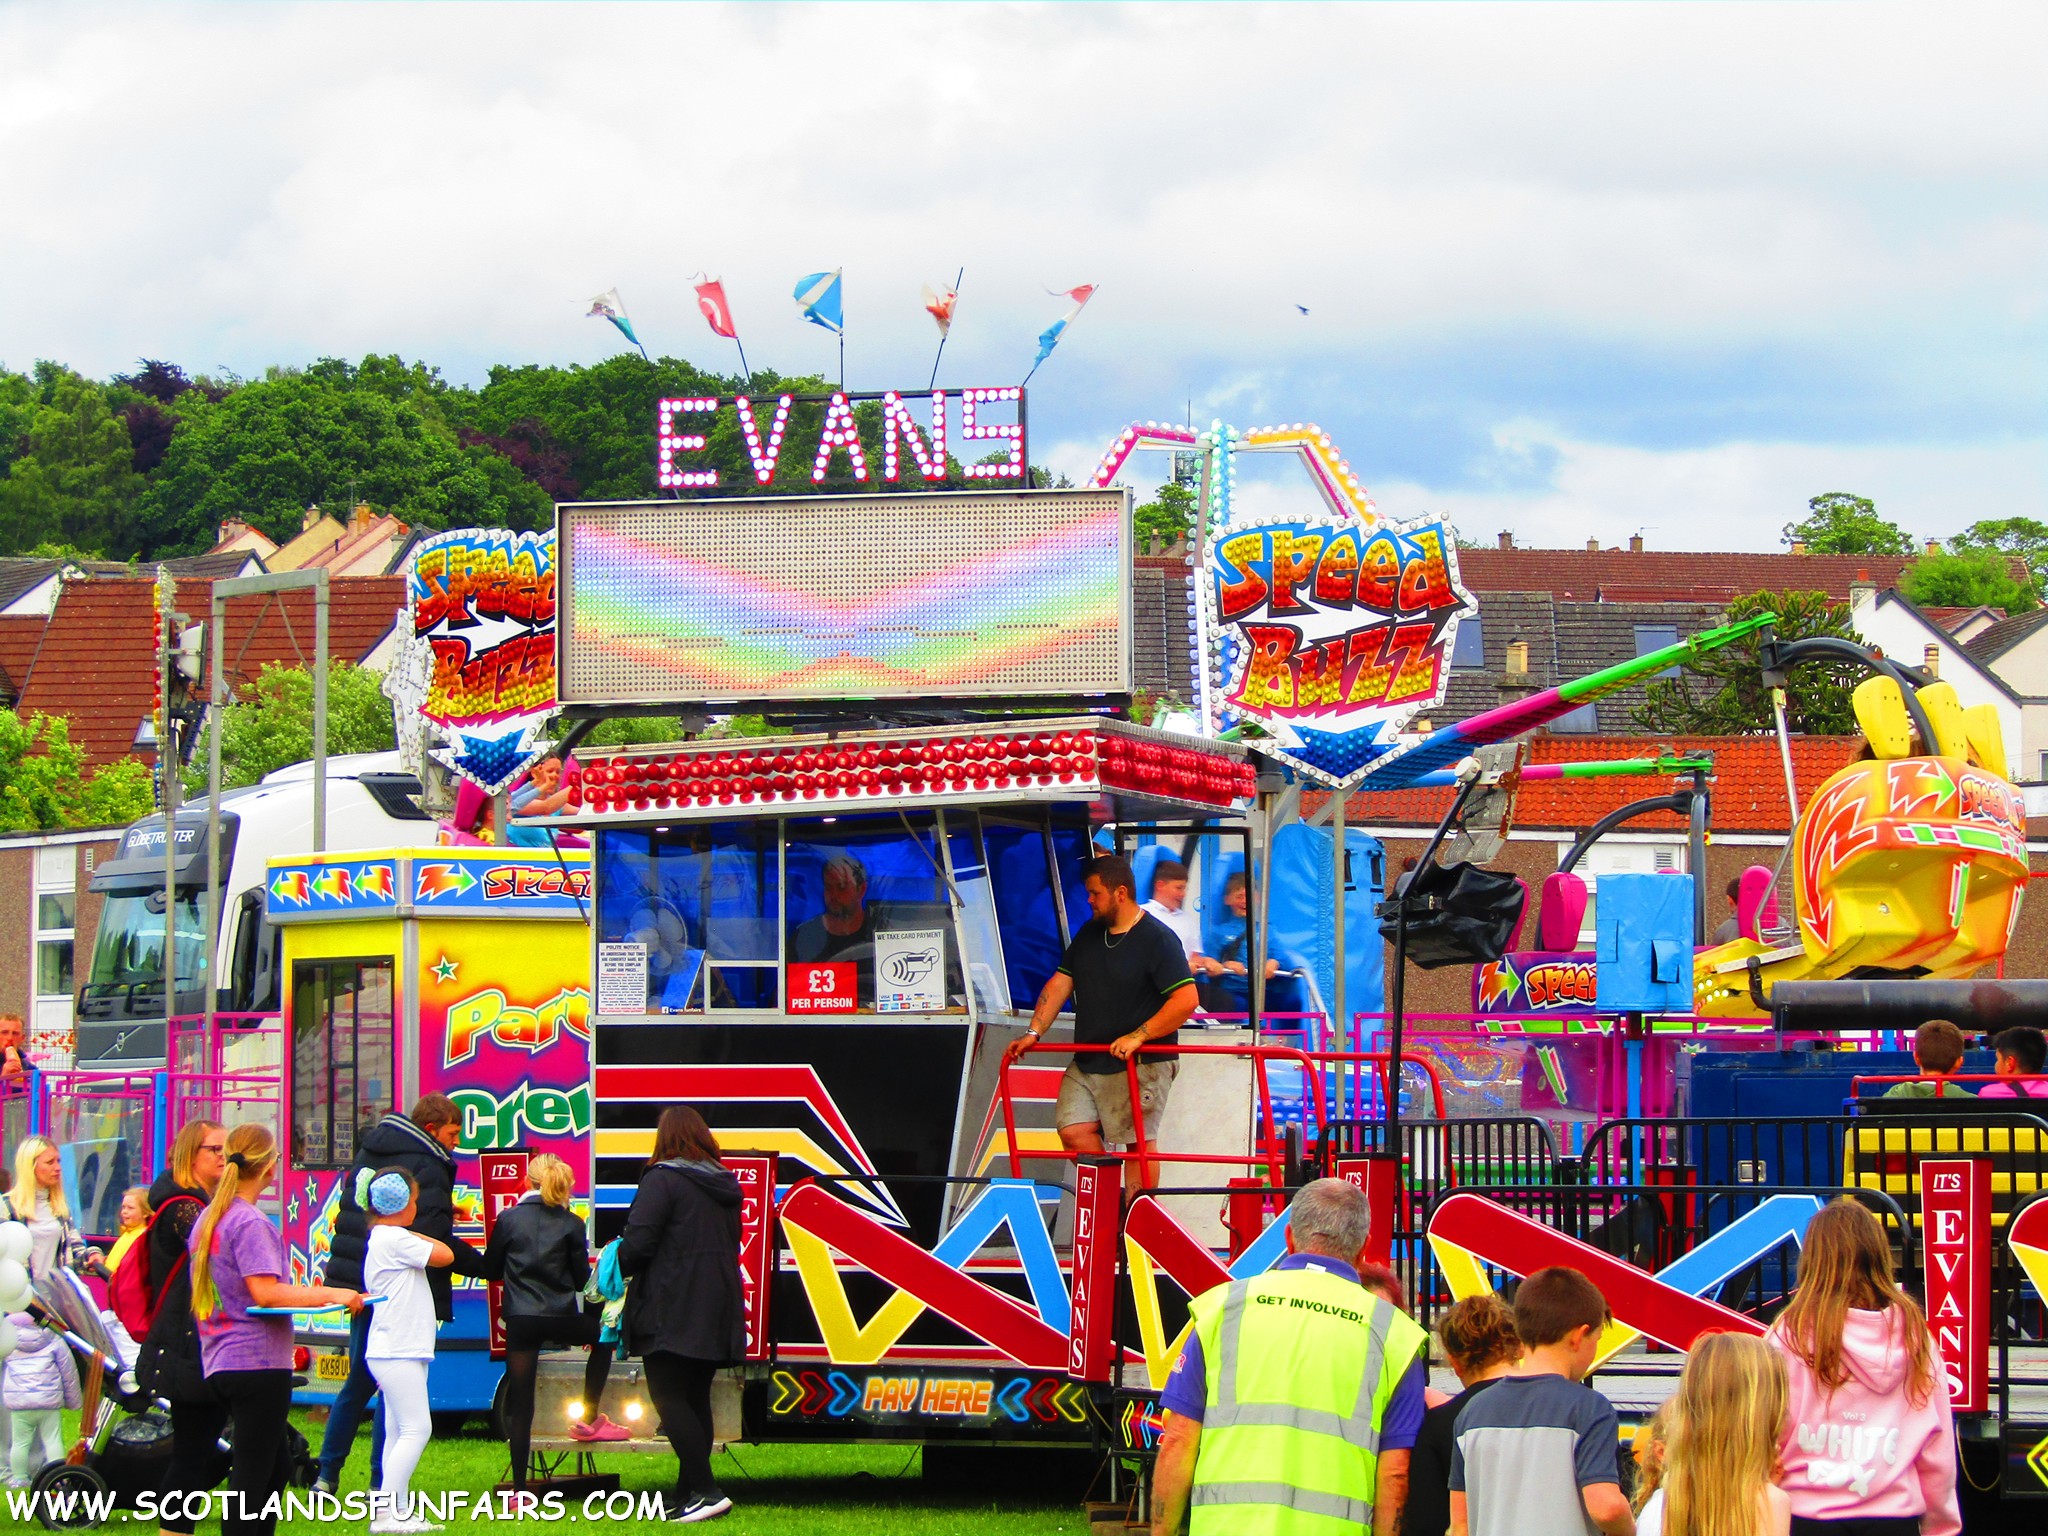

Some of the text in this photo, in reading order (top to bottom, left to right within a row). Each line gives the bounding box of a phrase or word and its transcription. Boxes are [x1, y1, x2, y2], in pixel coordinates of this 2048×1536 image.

[658, 386, 1024, 489] EVANS
[917, 931, 941, 939] PAYMENT
[808, 969, 836, 993] £3
[792, 997, 853, 1009] PER PERSON
[444, 988, 591, 1069] Part
[491, 1163, 518, 1177] IT'S
[732, 1168, 758, 1181] T'S
[1345, 1171, 1362, 1186] IT'S
[1080, 1176, 1093, 1189] IT'S
[1933, 1173, 1961, 1189] IT'S
[1071, 1207, 1092, 1370] EVANS
[1256, 1294, 1364, 1325] GET INVOLVED!
[1931, 1209, 1965, 1398] EVANS
[320, 1357, 340, 1376] GK58
[862, 1376, 994, 1416] PAY HERE
[1842, 1411, 1867, 1421] Vol 3
[1797, 1422, 1899, 1466] WHITE
